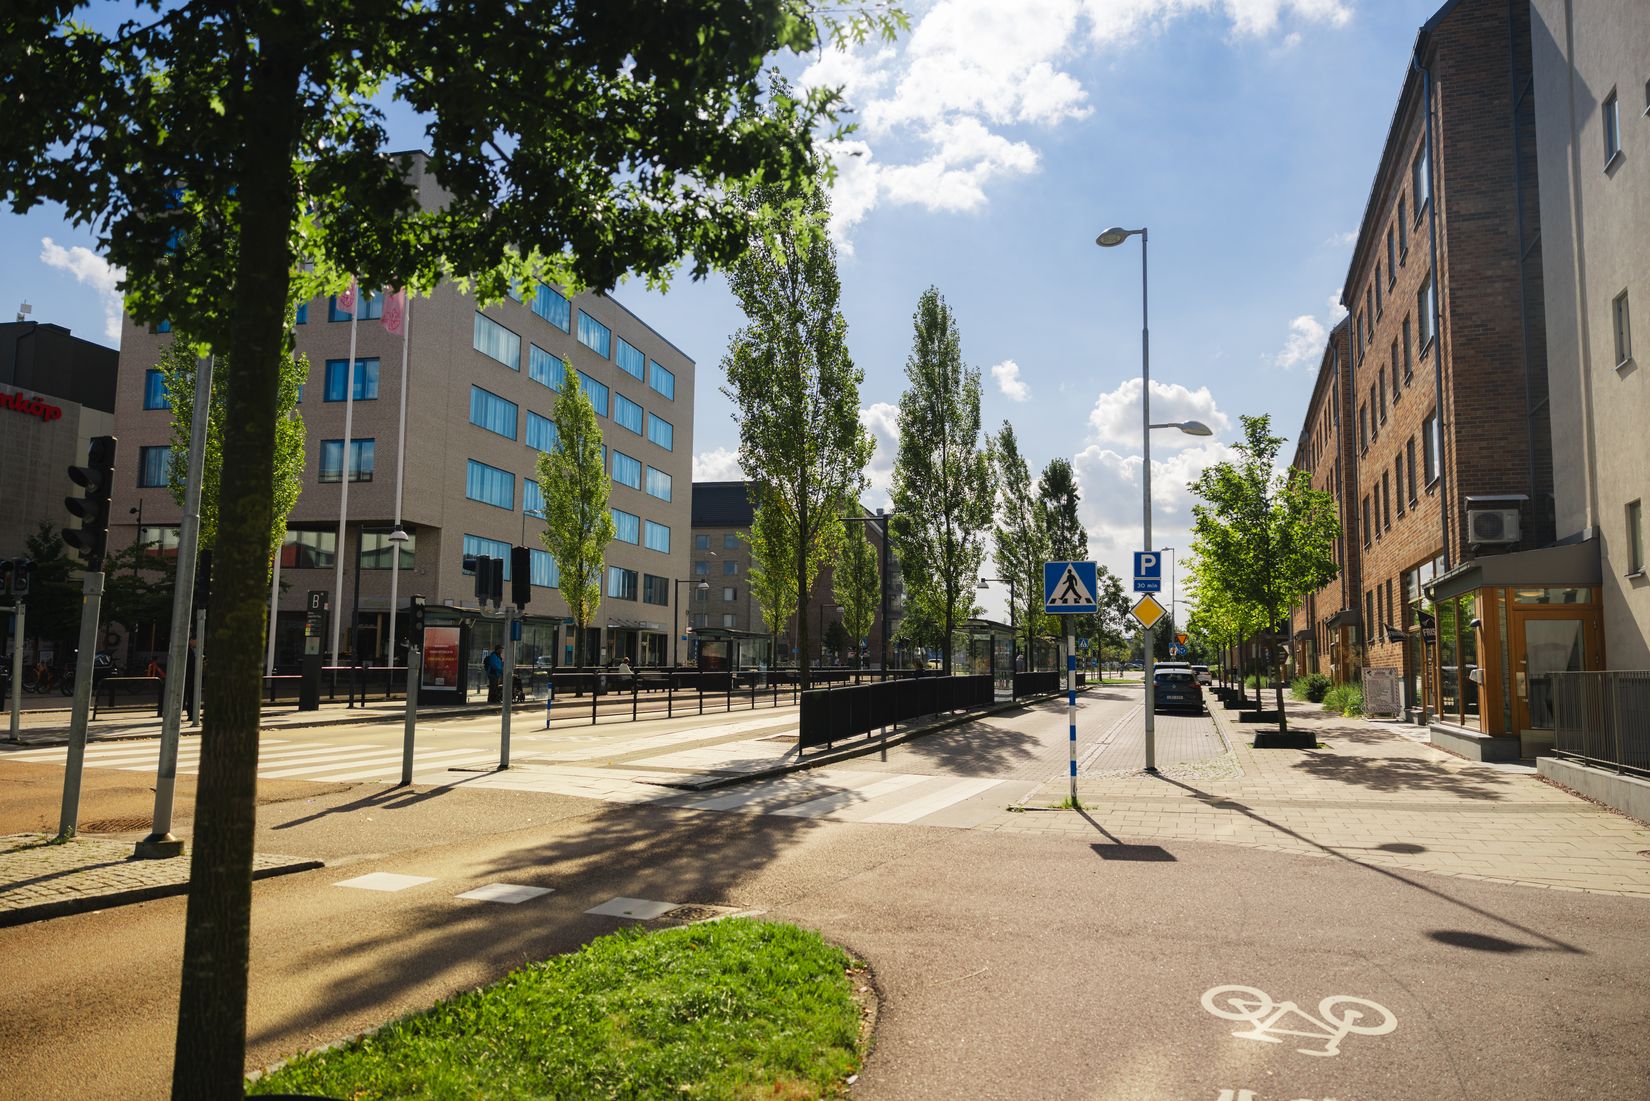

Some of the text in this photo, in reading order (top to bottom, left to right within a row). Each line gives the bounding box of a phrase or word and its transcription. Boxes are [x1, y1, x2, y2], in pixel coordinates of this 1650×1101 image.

[0, 391, 62, 422] nköp
[1141, 554, 1156, 576] P
[312, 594, 320, 609] B
